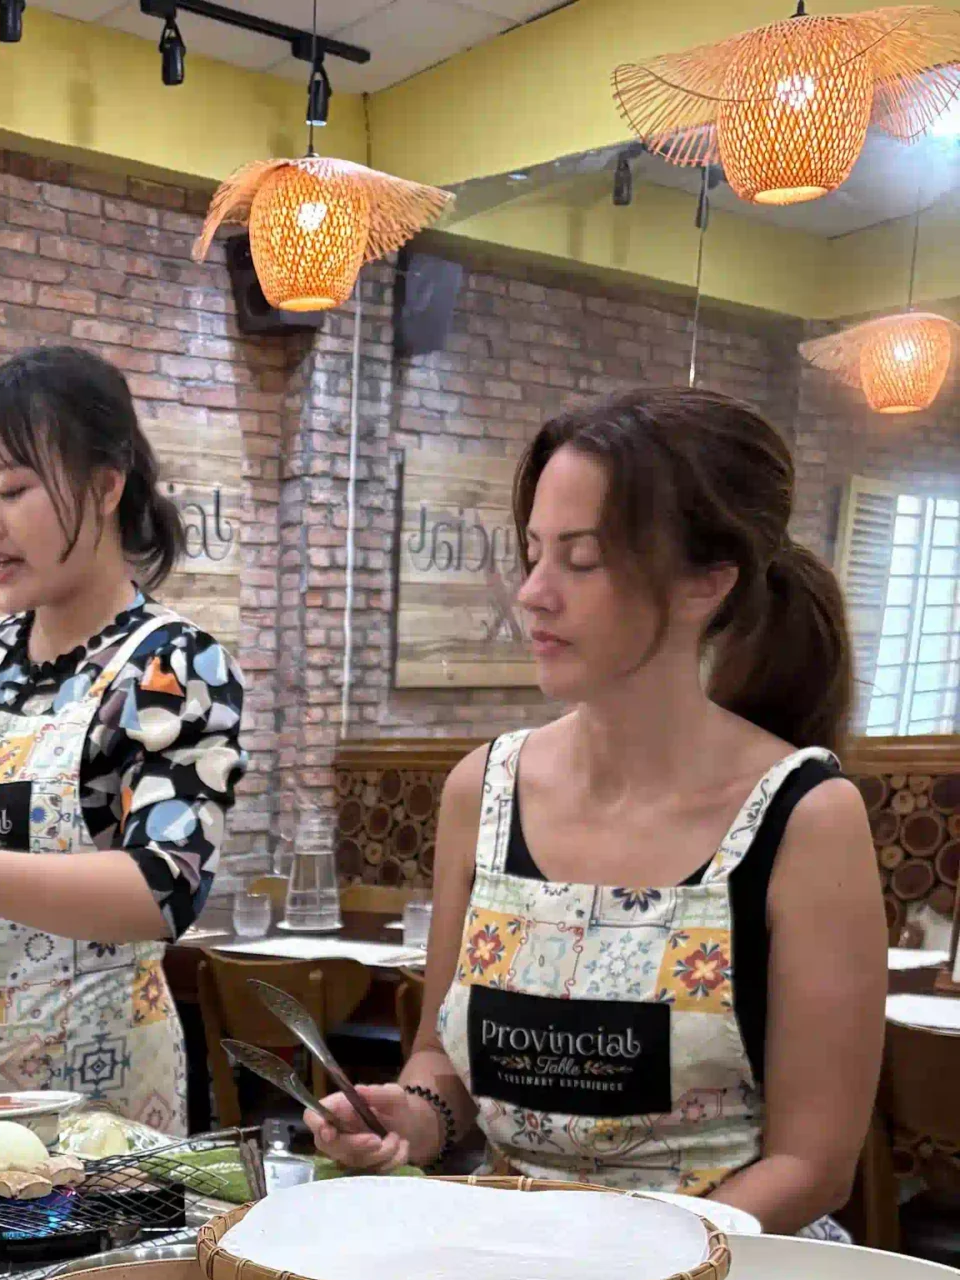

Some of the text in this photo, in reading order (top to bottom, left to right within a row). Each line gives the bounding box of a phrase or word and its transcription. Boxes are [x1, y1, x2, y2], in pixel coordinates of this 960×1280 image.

[481, 1019, 641, 1058] Provincial
[534, 1055, 581, 1076] Table
[559, 1078, 624, 1092] EXPERIENCE
